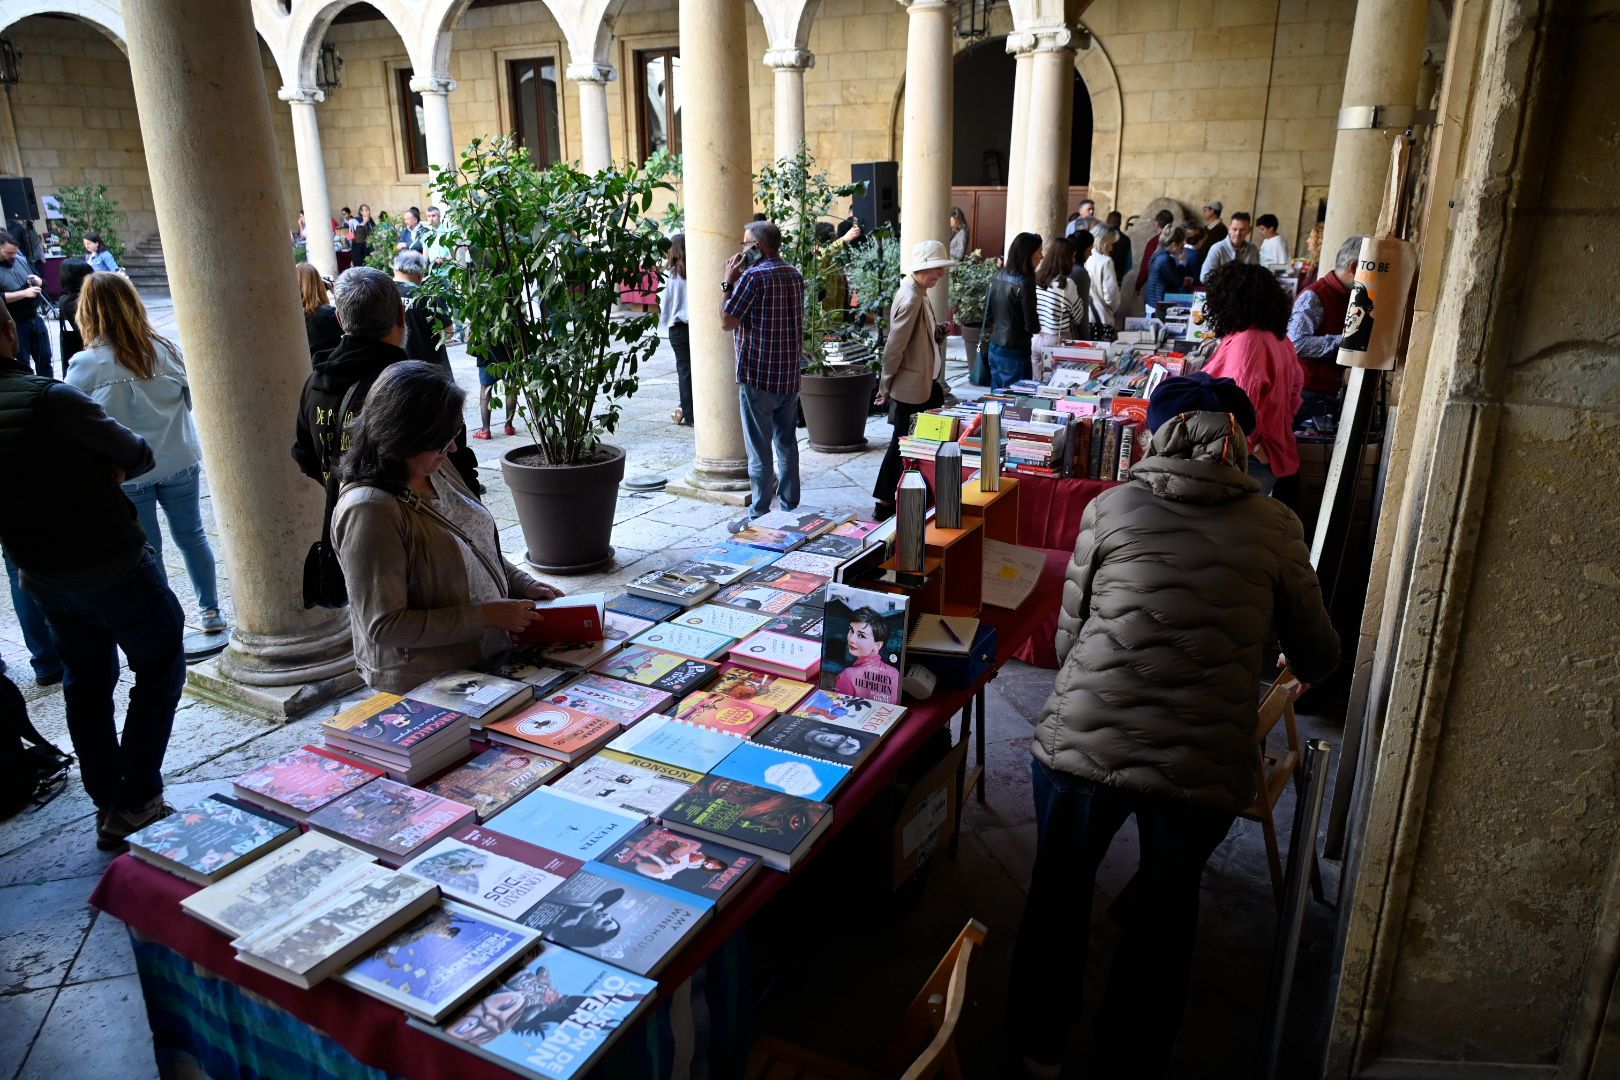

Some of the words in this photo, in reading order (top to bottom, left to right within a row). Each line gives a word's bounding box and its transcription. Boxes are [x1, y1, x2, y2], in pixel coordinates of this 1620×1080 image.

[1361, 261, 1375, 272] TO
[1378, 262, 1390, 273] BE
[855, 678, 892, 695] HEPBURN
[863, 670, 893, 685] AUDREY
[396, 711, 461, 746] ZEROCALCARE
[861, 705, 897, 733] ZWEIG
[626, 759, 693, 779] RONSON
[572, 822, 623, 851] PUENTES
[482, 876, 521, 902] DIOS
[496, 872, 548, 909] CONTRATO
[668, 911, 693, 931] AMY
[469, 936, 513, 967] MIGUEL
[617, 979, 642, 997] LA
[525, 973, 628, 1067] OVERLAIN
[570, 998, 623, 1052] ILUSIÓN
[545, 1051, 575, 1074] DE
